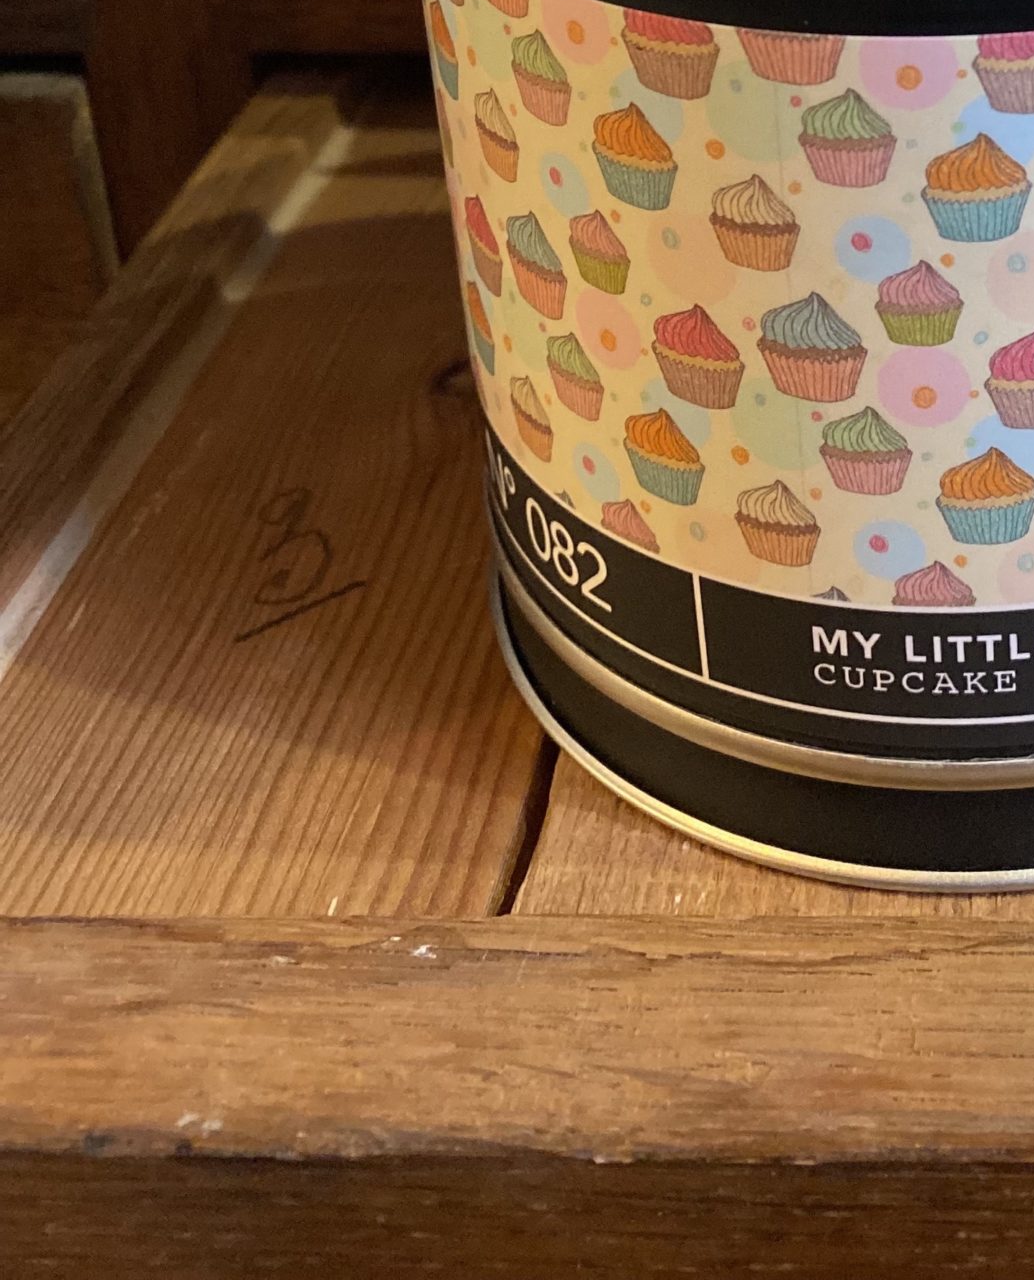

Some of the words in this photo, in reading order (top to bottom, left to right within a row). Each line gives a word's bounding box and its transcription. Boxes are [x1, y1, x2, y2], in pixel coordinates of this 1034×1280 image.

[526, 497, 612, 613] 082
[811, 625, 881, 659] MY
[813, 663, 1017, 695] CUPCAKE
